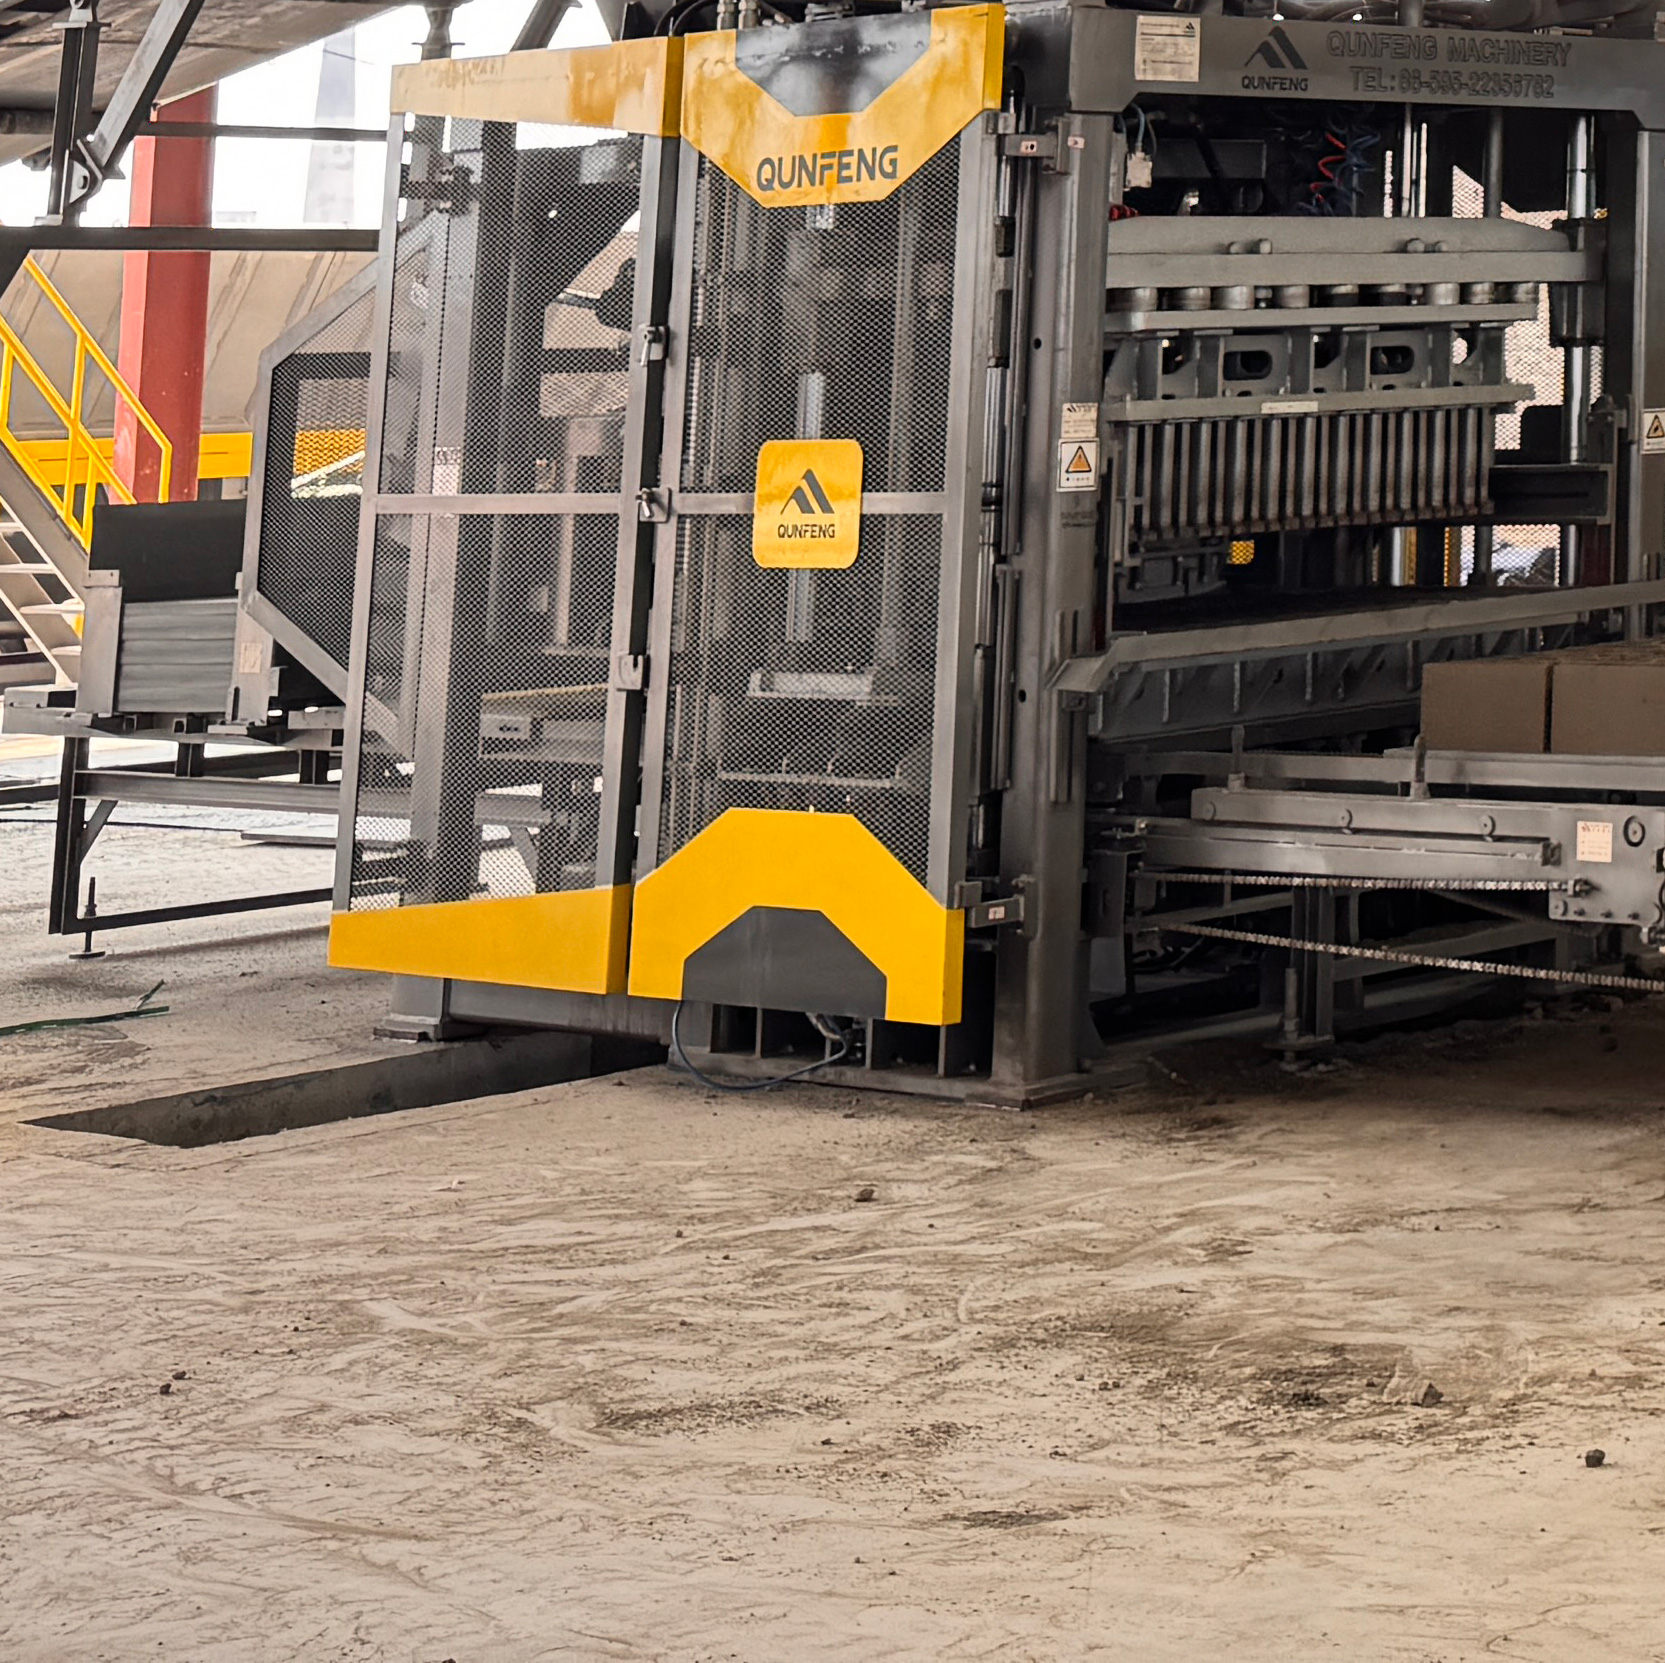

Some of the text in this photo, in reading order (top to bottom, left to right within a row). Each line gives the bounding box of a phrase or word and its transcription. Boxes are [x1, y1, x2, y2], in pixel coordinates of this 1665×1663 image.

[1327, 30, 1572, 67] QUNFENG MACHINERY
[1241, 75, 1309, 92] QUNFENG
[756, 144, 899, 192] QUNFENG
[777, 523, 836, 539] QUNFENG
